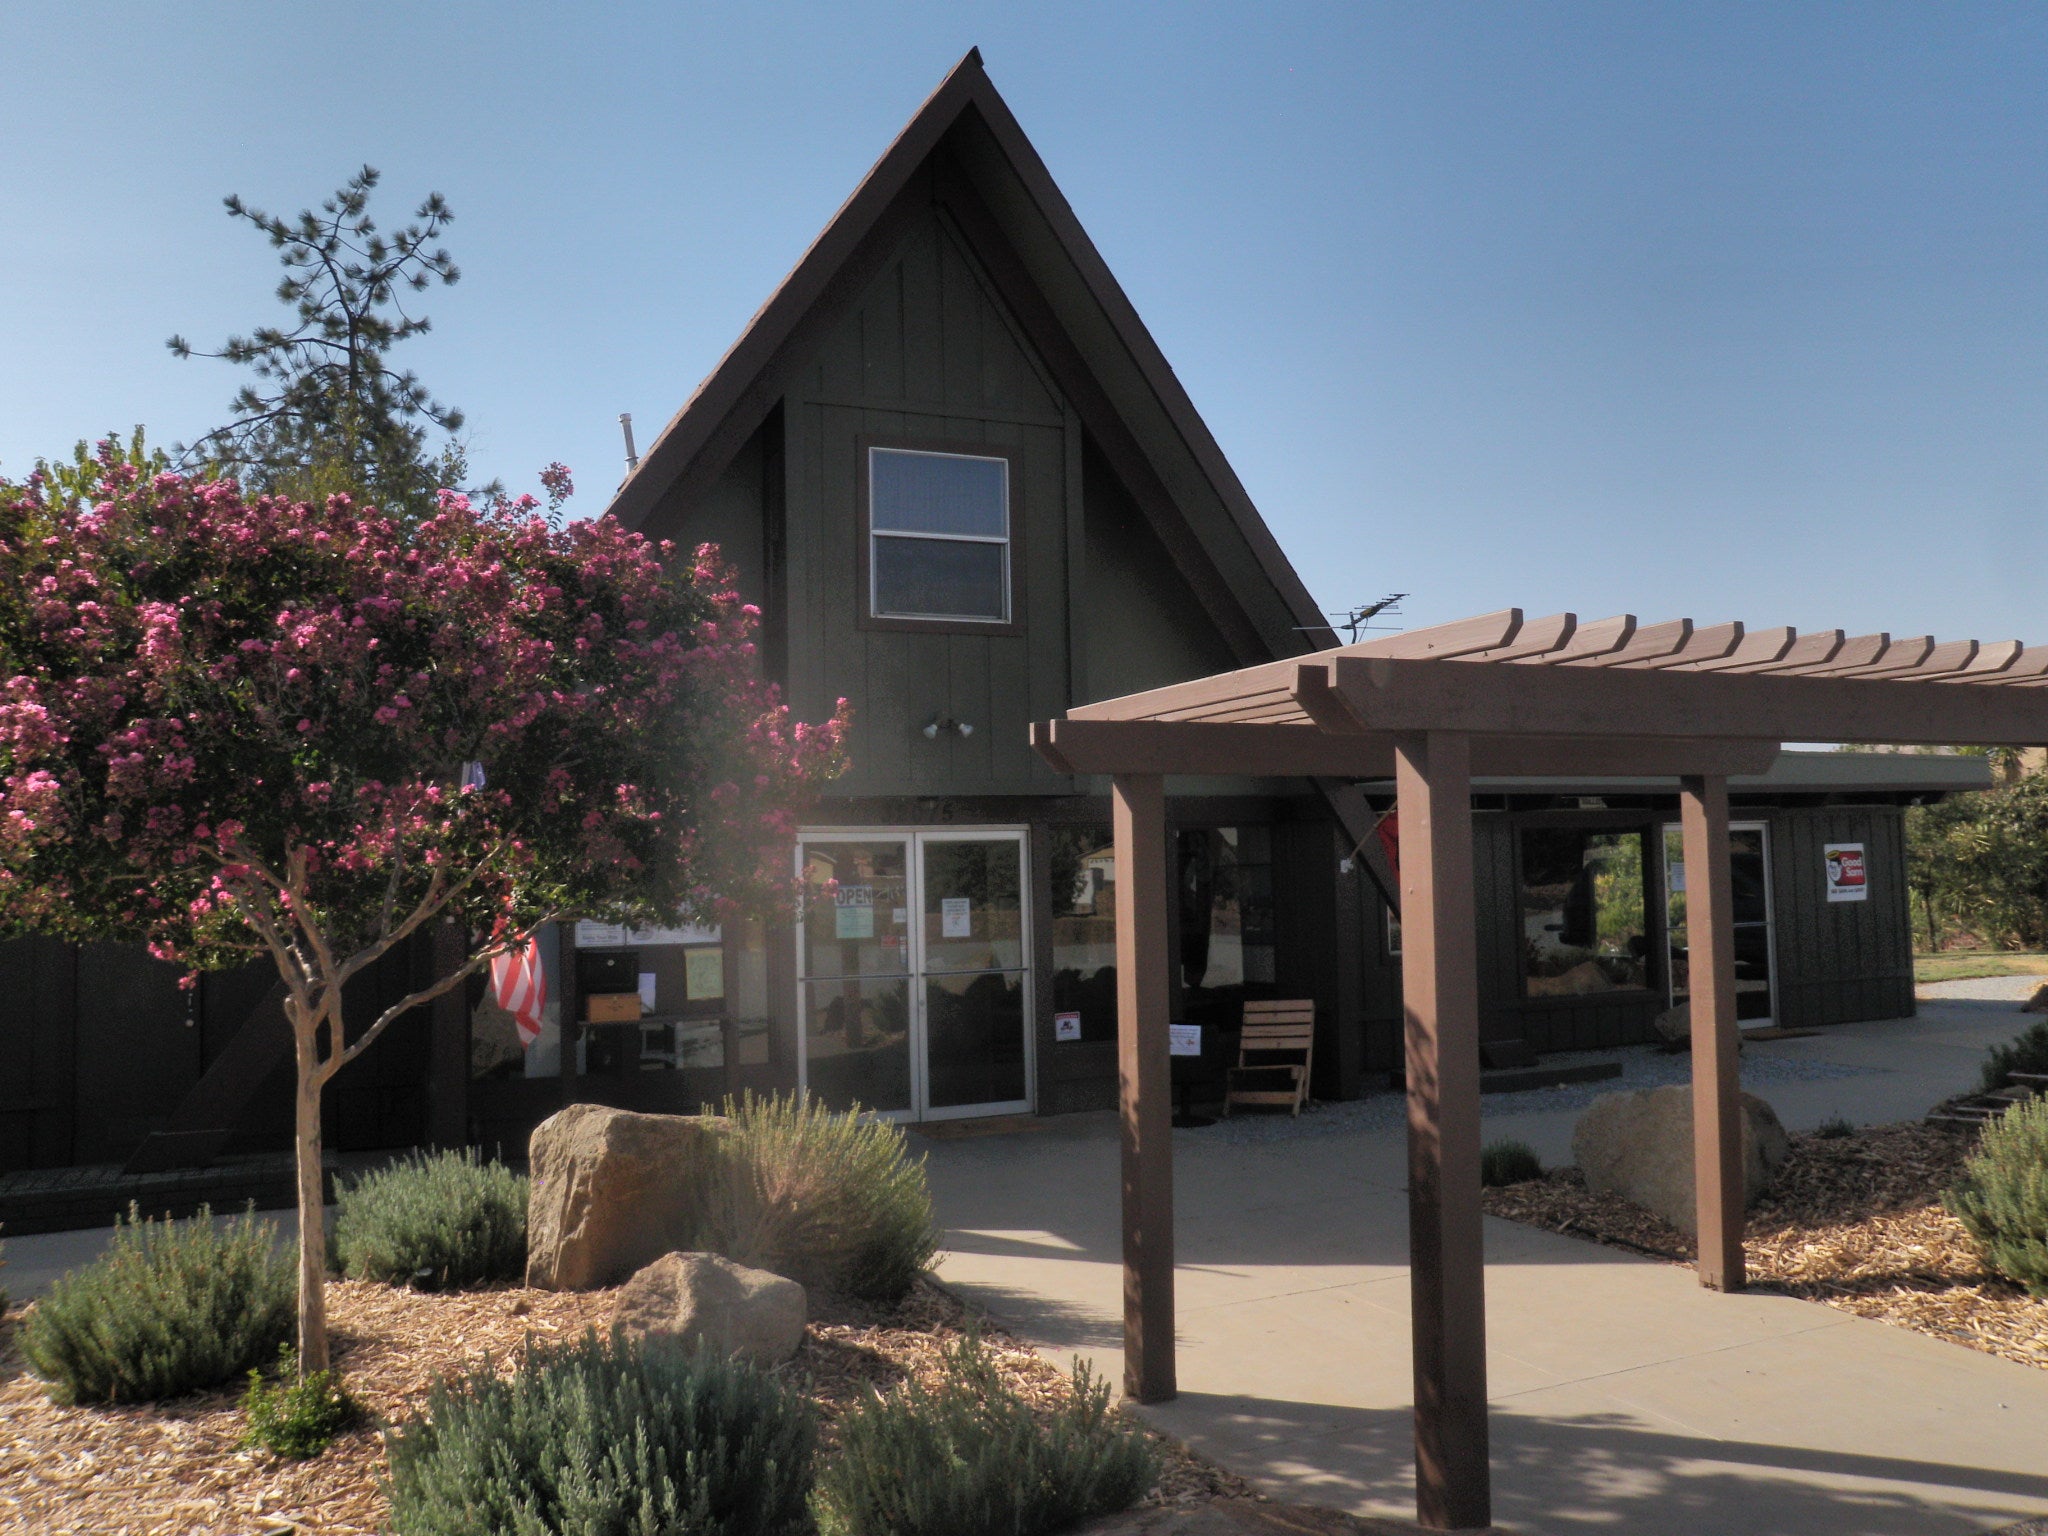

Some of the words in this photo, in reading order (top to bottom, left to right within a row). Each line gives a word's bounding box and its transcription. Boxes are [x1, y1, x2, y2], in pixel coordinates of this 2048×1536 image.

[1841, 856, 1862, 867] Good
[1846, 867, 1863, 877] Sam
[837, 889, 871, 905] OPEN
